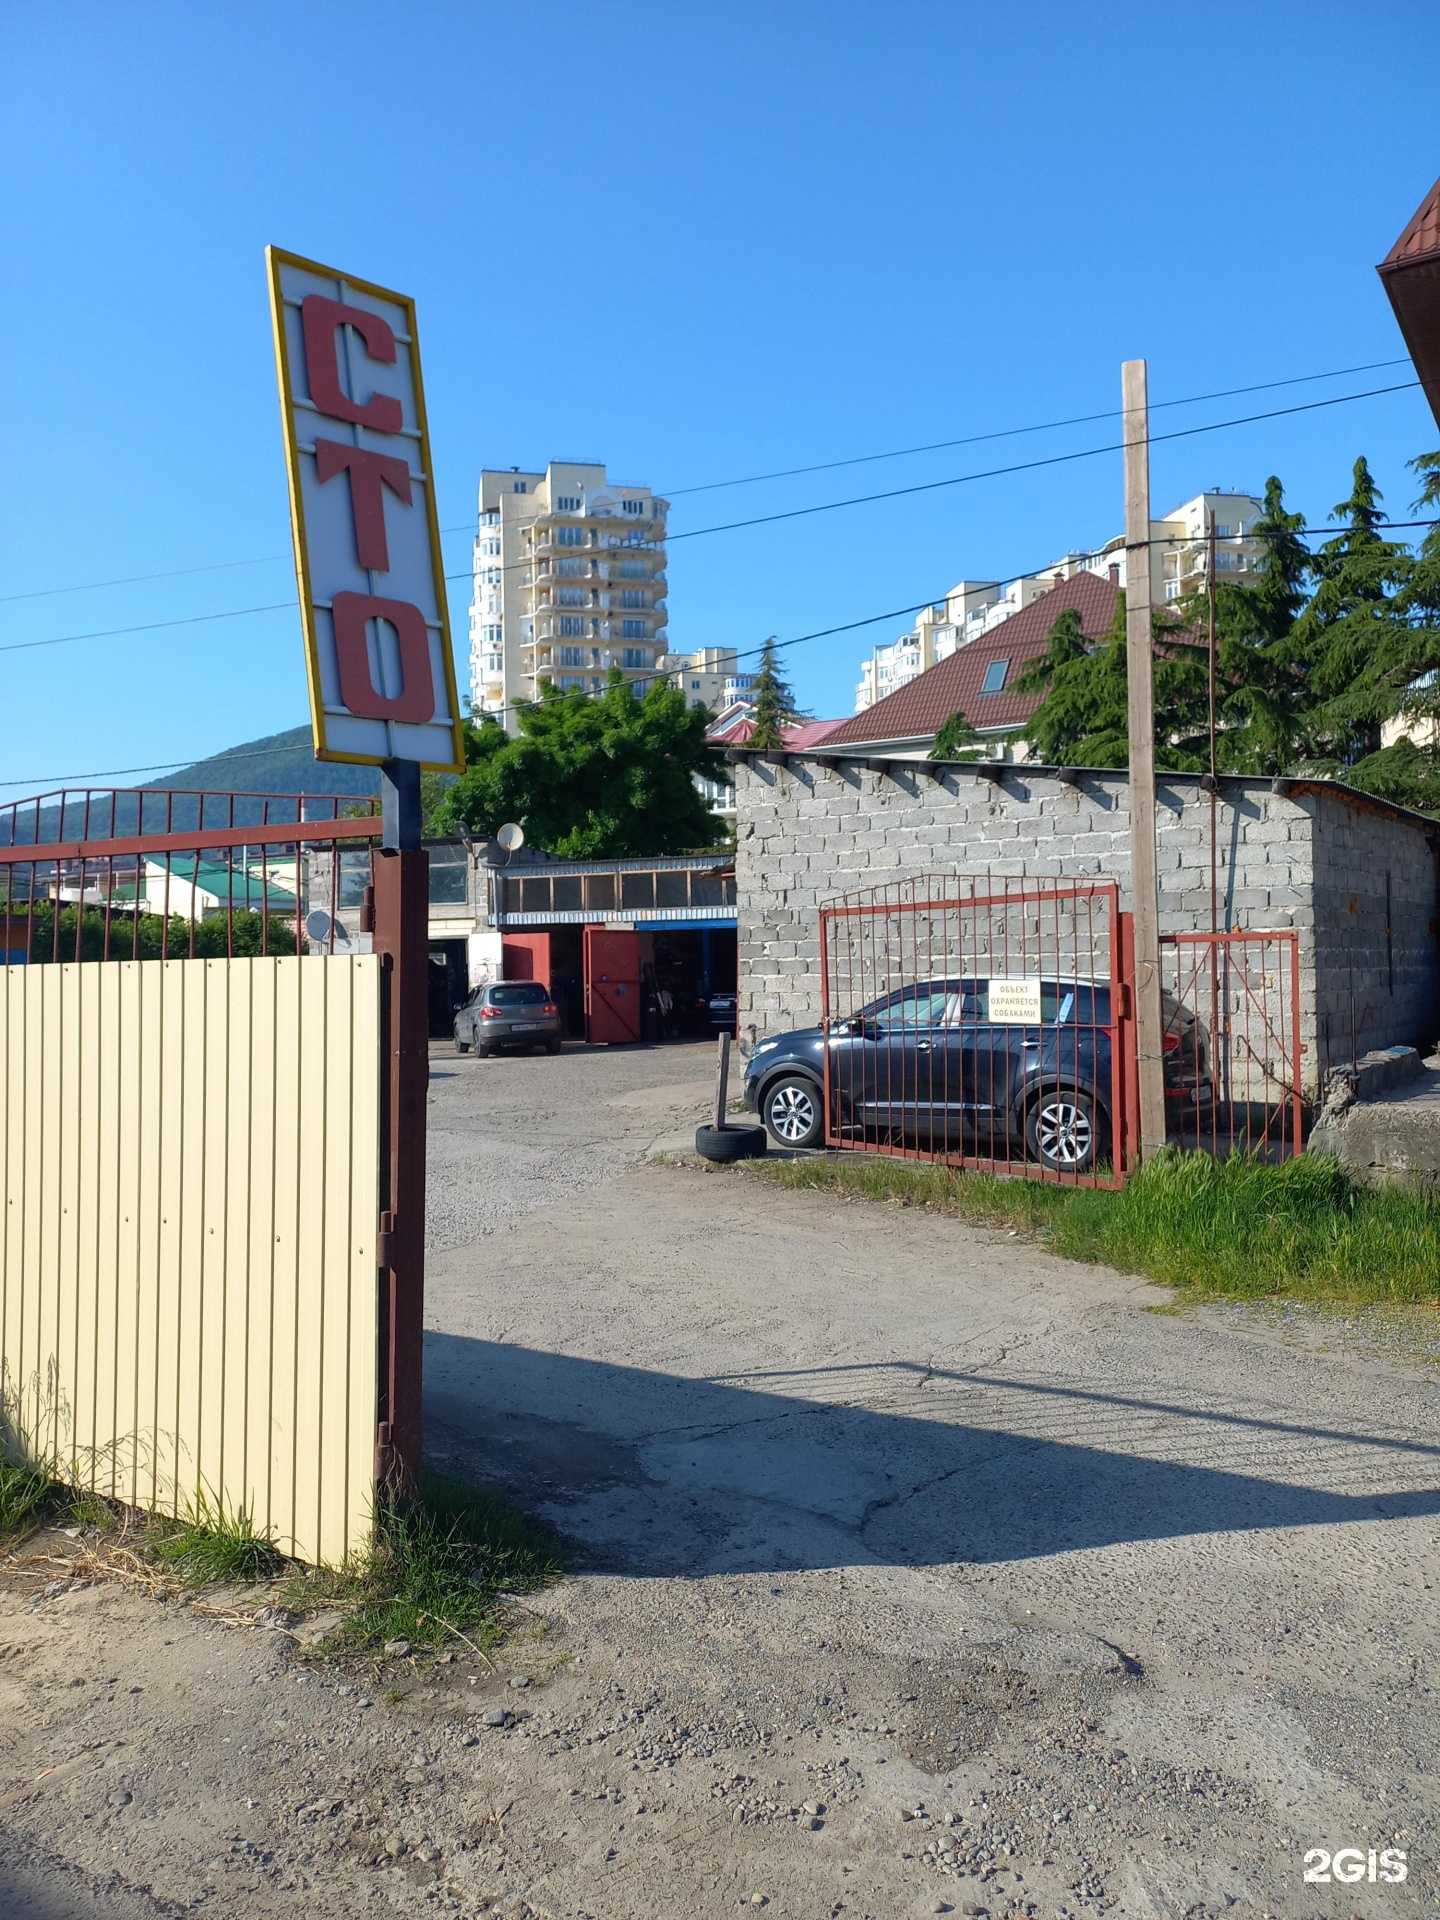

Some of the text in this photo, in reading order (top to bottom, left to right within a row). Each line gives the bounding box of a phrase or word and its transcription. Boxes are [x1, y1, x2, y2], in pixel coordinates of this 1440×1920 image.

[302, 294, 435, 723] СТО
[1000, 985, 1028, 993] ОБЪЕКТ
[990, 997, 1039, 1006] ОХРАНЯЕТСЯ
[994, 1009, 1036, 1018] СОБАКАМИ
